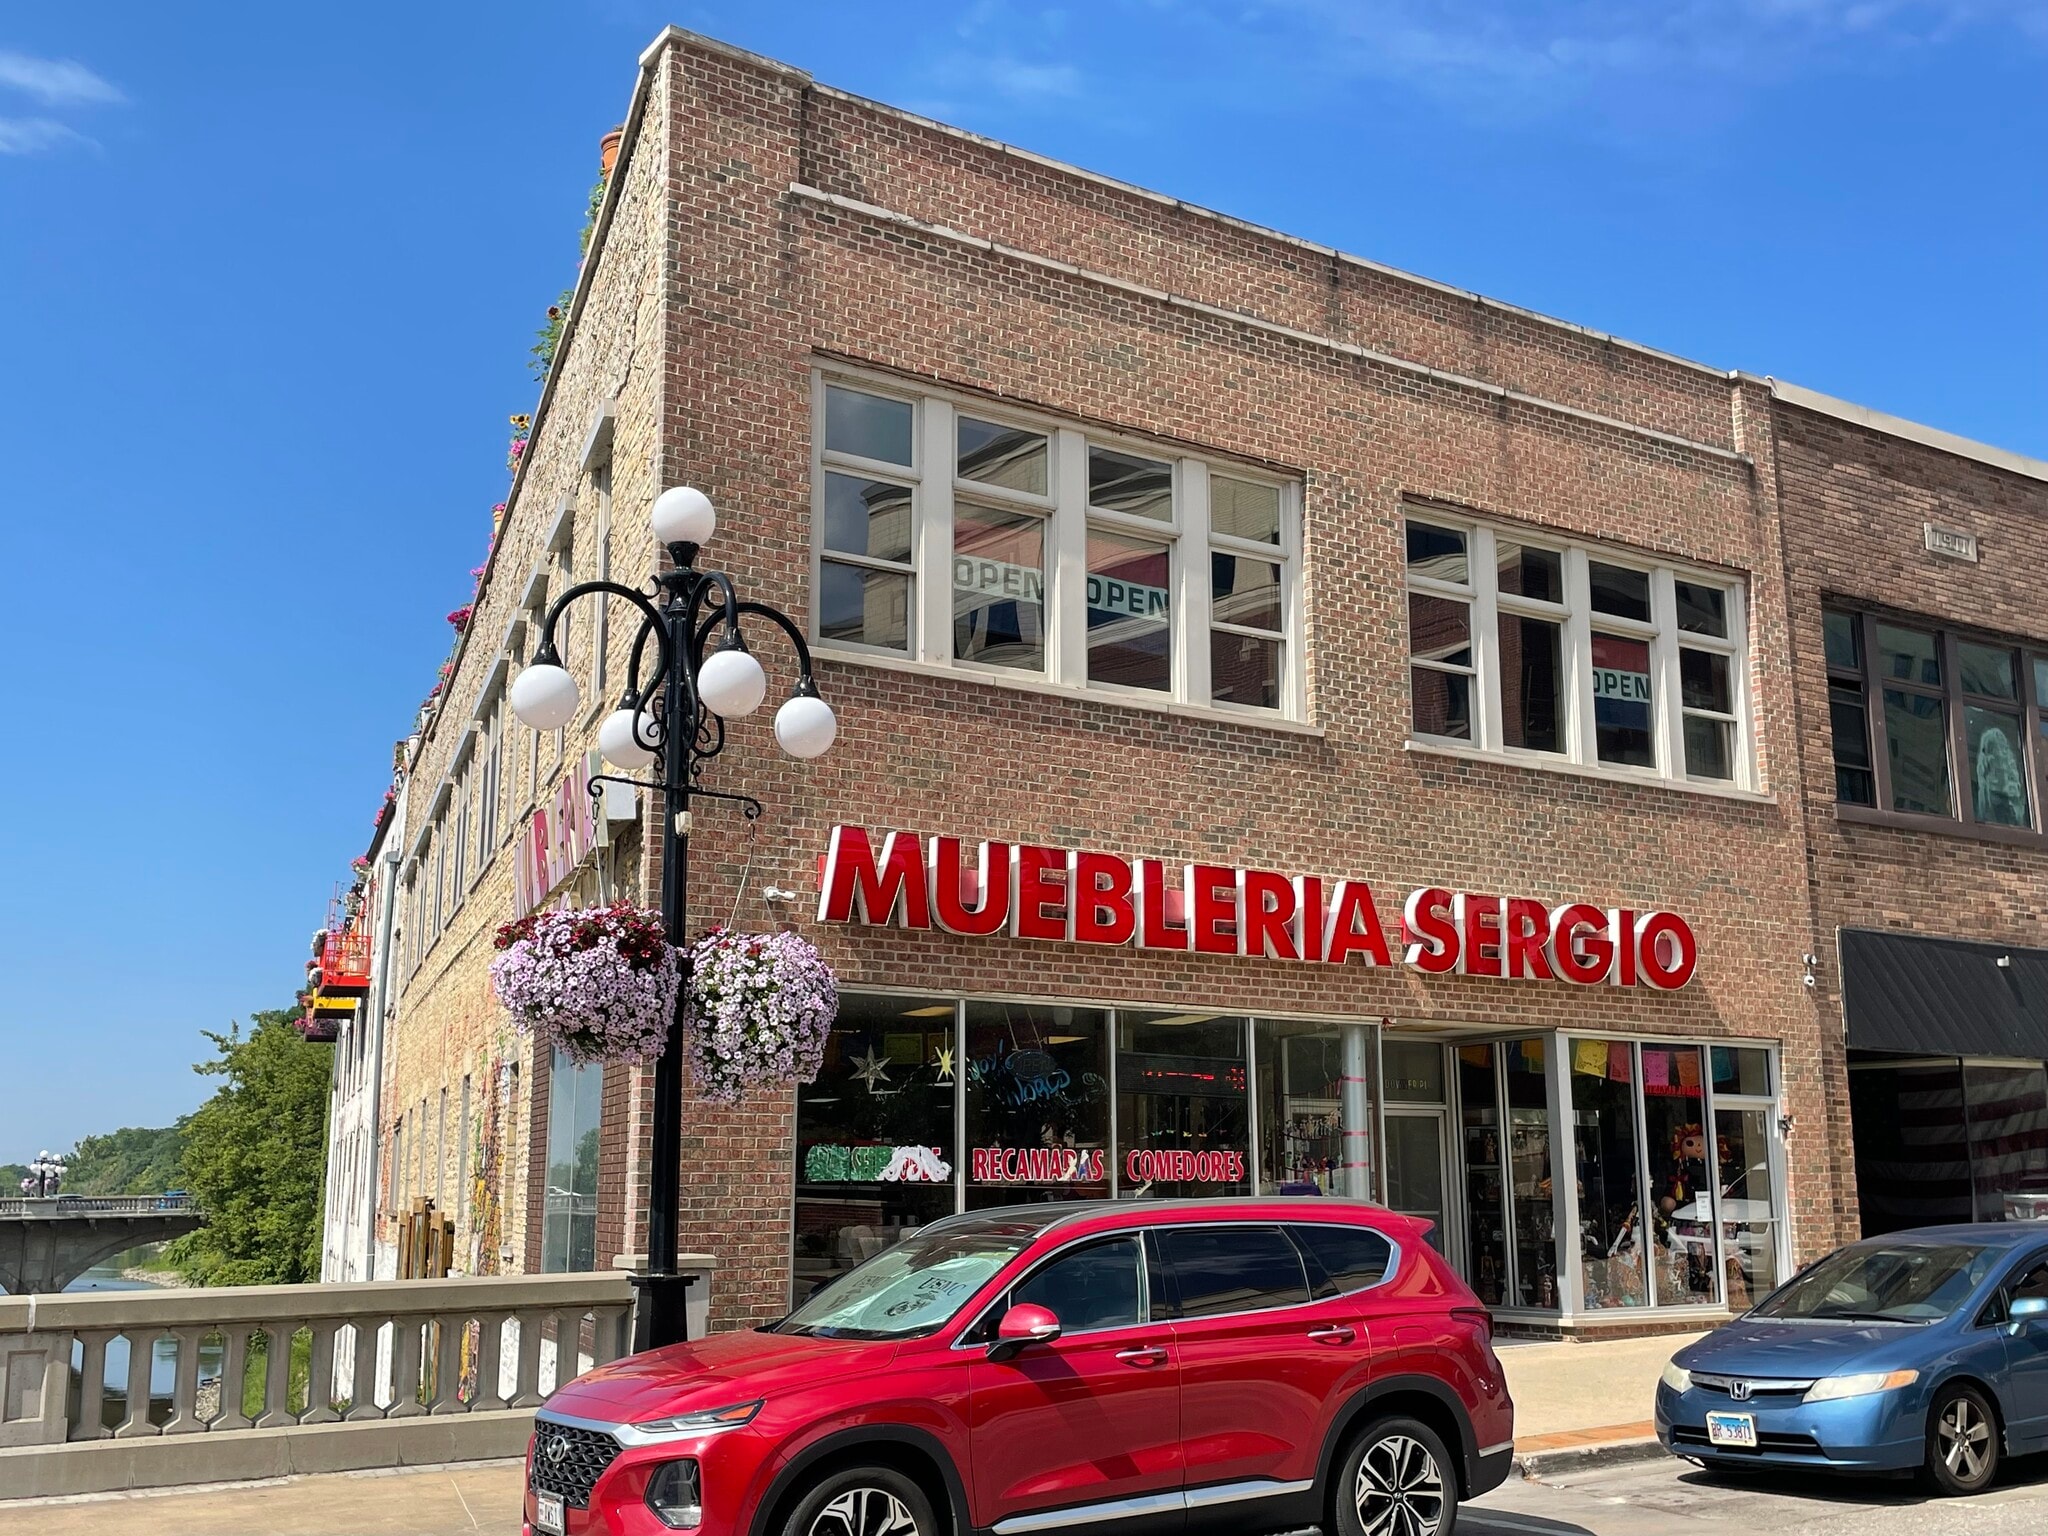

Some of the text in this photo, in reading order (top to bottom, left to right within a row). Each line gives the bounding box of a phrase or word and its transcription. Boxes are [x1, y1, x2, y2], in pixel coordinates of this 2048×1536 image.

[953, 558, 1043, 600] OPEN
[1087, 577, 1169, 618] OPEN
[1593, 670, 1649, 699] OPEN
[817, 825, 1698, 991] MUEBLERIA SERGIO
[972, 1148, 1104, 1182] RECAMARAS
[1126, 1150, 1244, 1182] COMEDORES
